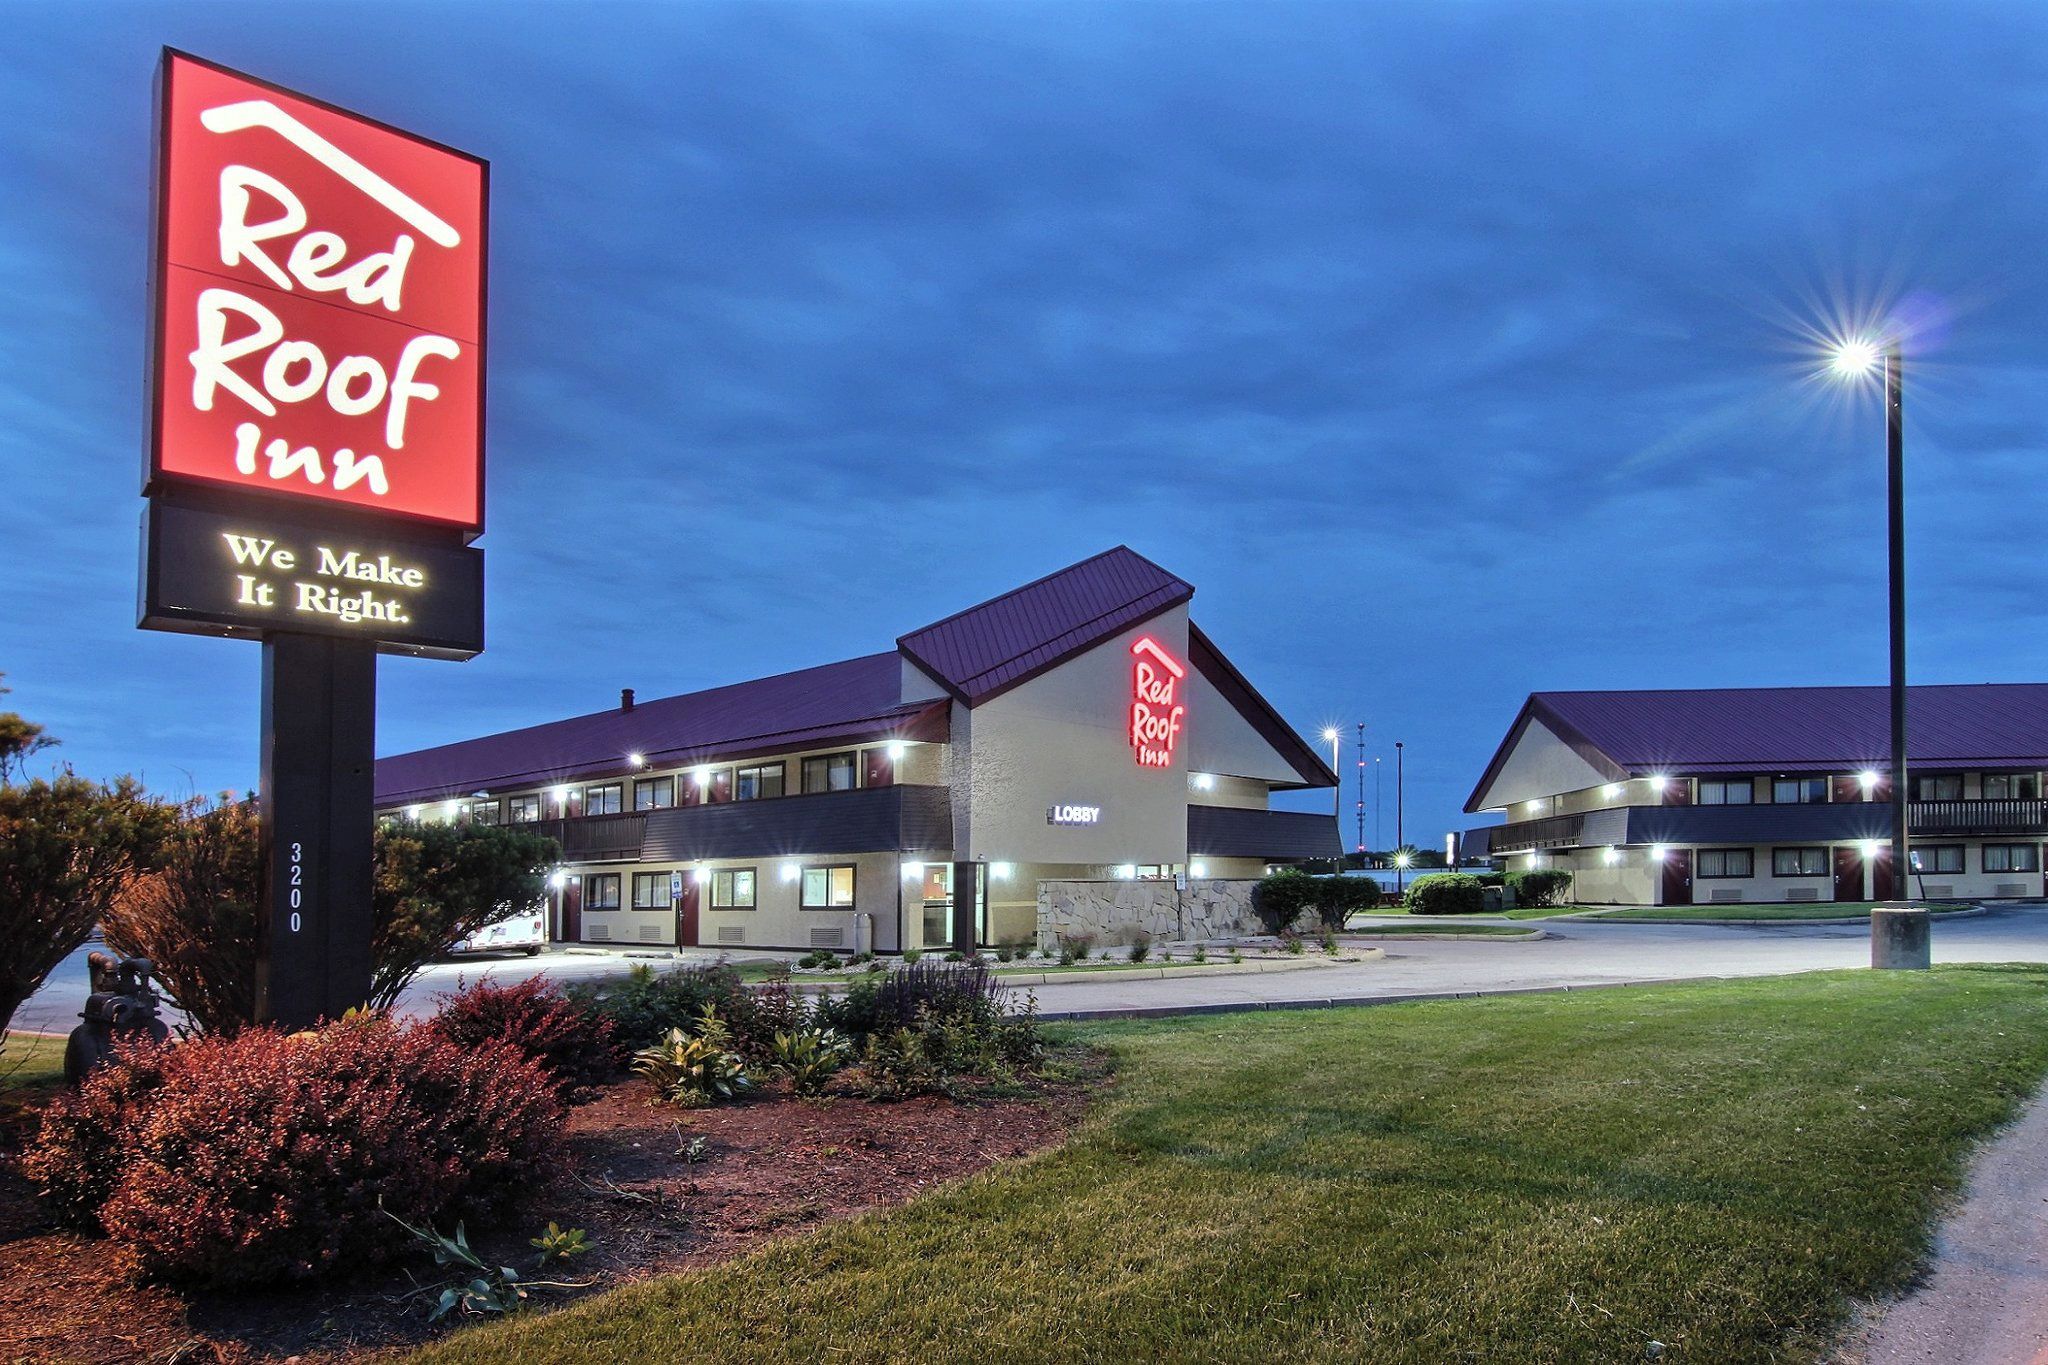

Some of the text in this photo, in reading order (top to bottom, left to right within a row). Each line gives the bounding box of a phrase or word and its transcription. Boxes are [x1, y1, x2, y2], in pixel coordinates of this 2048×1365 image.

[218, 164, 415, 313] Red
[188, 287, 461, 450] Roof
[235, 421, 389, 496] Inn
[222, 533, 425, 588] We Make
[237, 574, 410, 624] It Right.
[1136, 662, 1175, 706] Red
[1132, 702, 1184, 751] Roof
[1139, 745, 1170, 767] Inn
[1054, 805, 1100, 823] LOBBY
[290, 841, 302, 933] 3200
